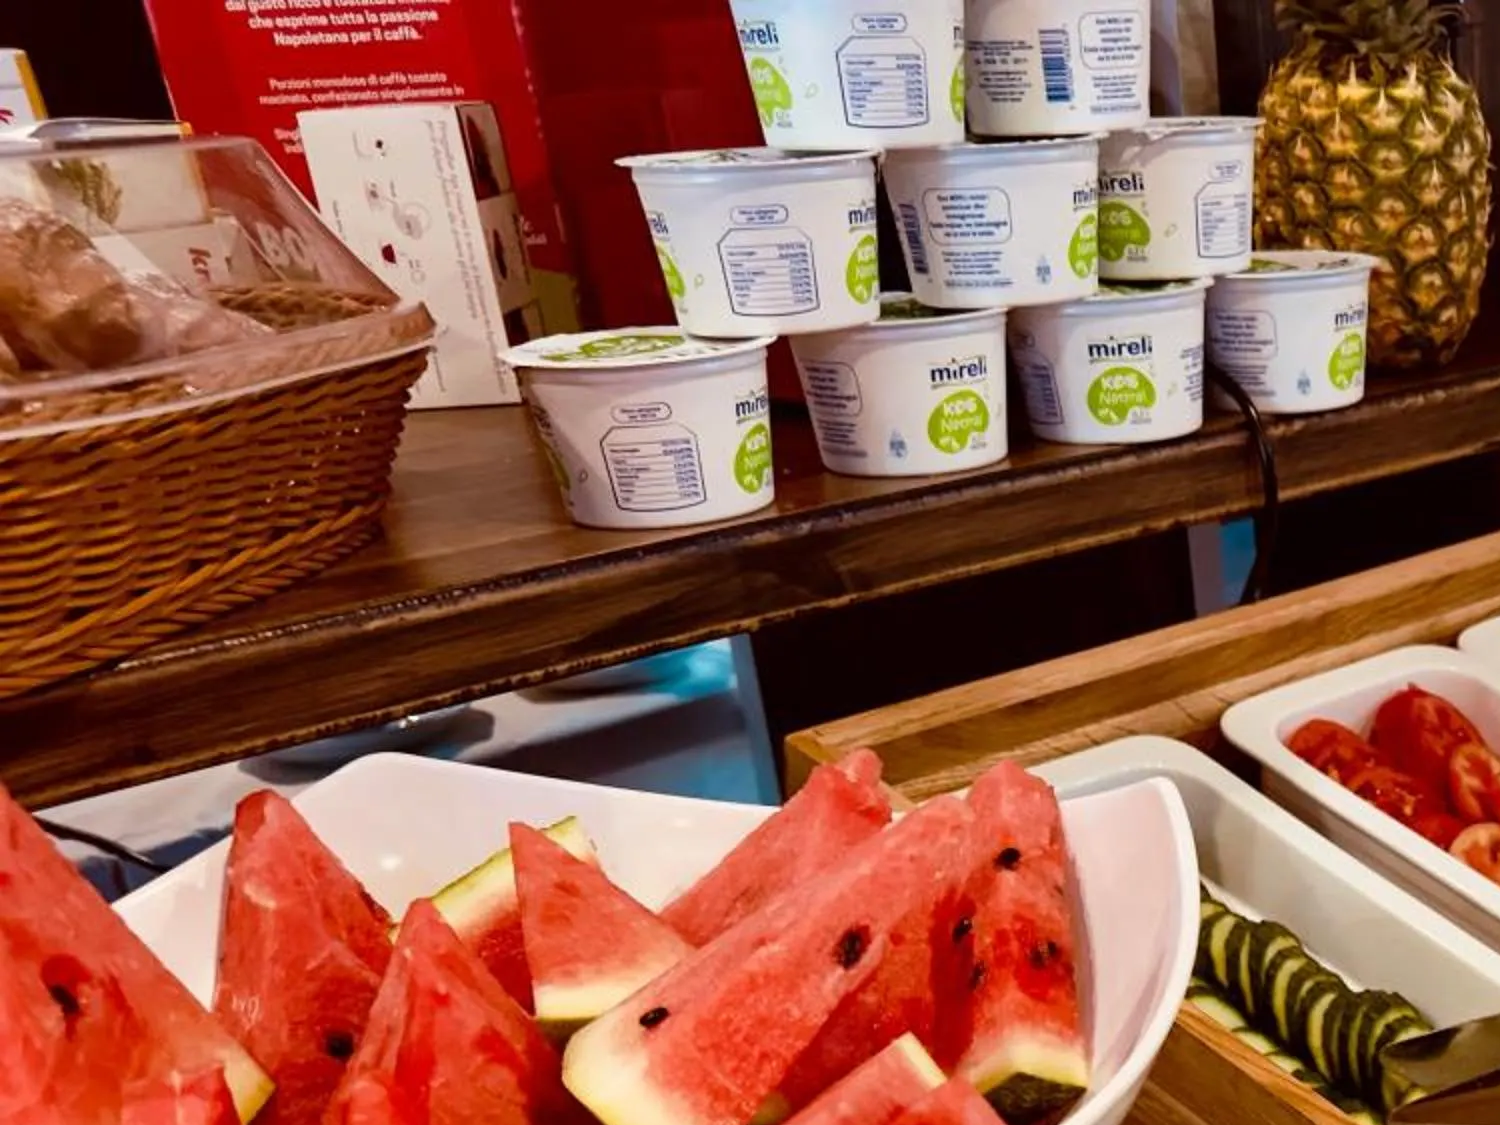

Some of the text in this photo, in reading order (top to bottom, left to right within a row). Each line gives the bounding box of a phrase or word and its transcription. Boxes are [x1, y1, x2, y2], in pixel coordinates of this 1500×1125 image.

[248, 9, 439, 30] che esprime tutta la passione
[273, 30, 349, 47] Napoletana
[351, 30, 372, 45] per
[373, 28, 382, 41] il
[1087, 336, 1153, 358] mireli
[930, 356, 987, 382] mireli
